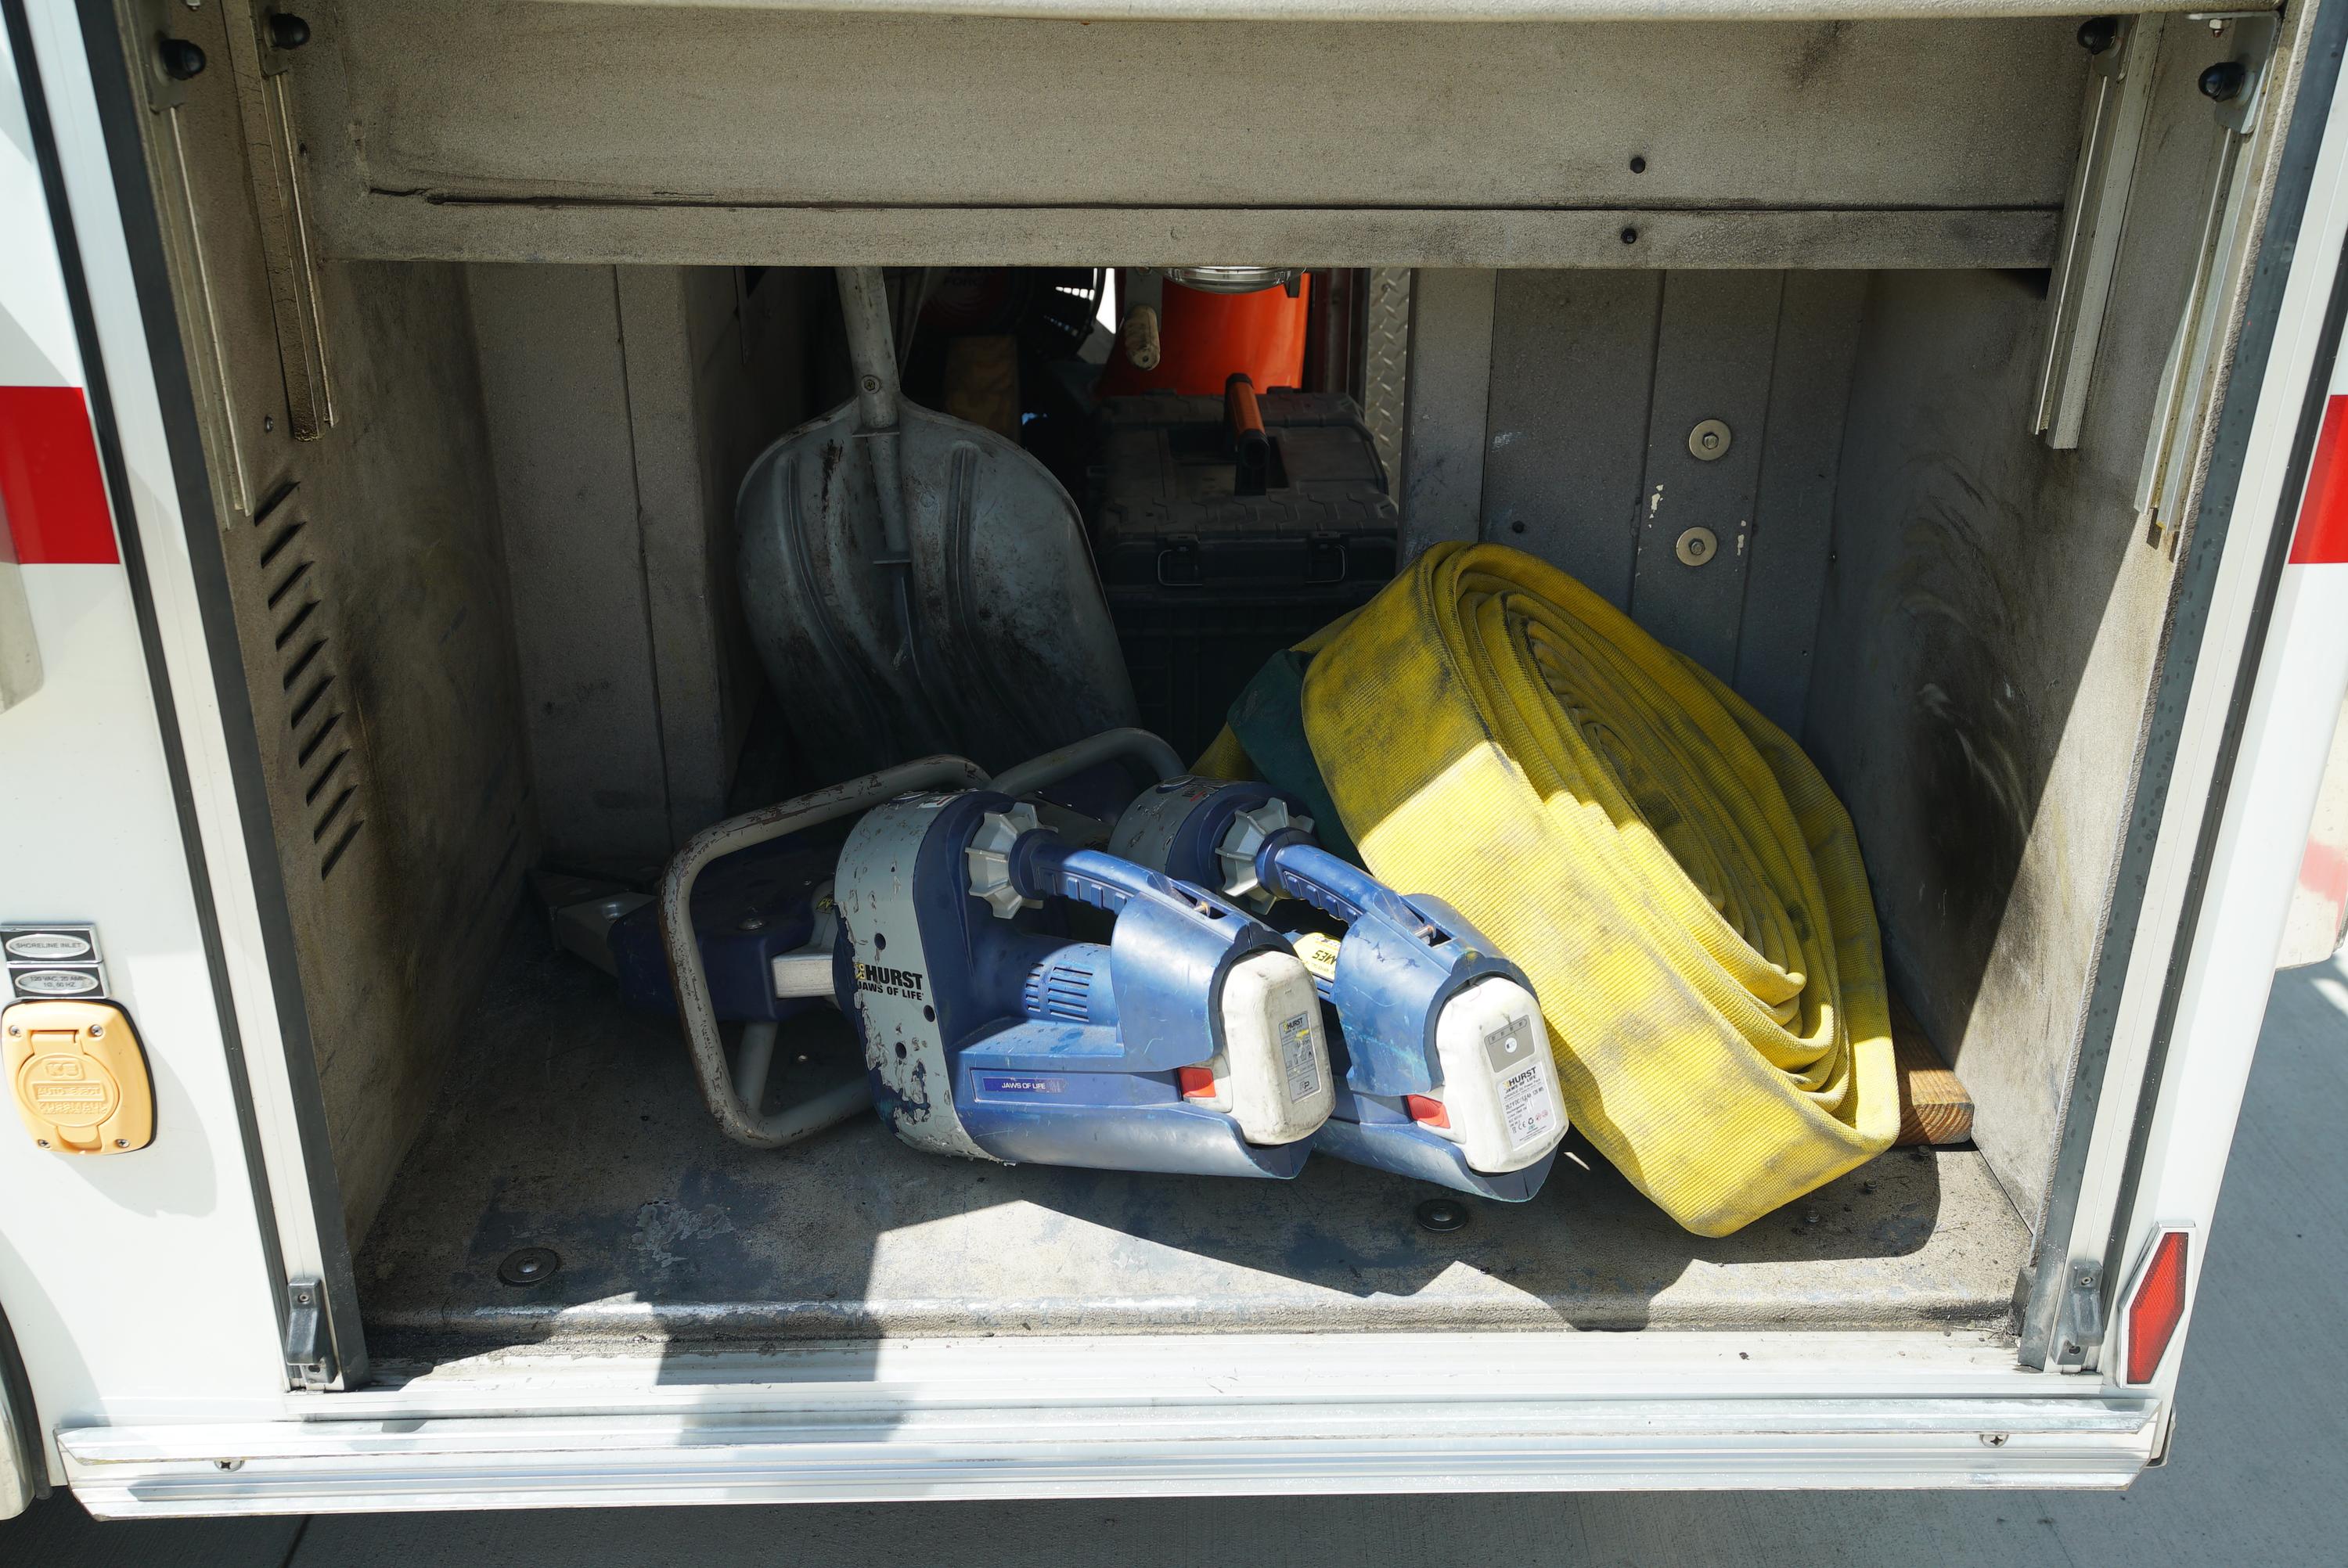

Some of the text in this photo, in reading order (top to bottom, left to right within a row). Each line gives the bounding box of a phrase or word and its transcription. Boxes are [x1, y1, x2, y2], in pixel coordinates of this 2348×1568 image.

[865, 964, 923, 991] HURST
[859, 980, 922, 1001] JAWS OF LIFE
[1287, 1017, 1303, 1030] HURST
[1509, 1066, 1536, 1087] HURST
